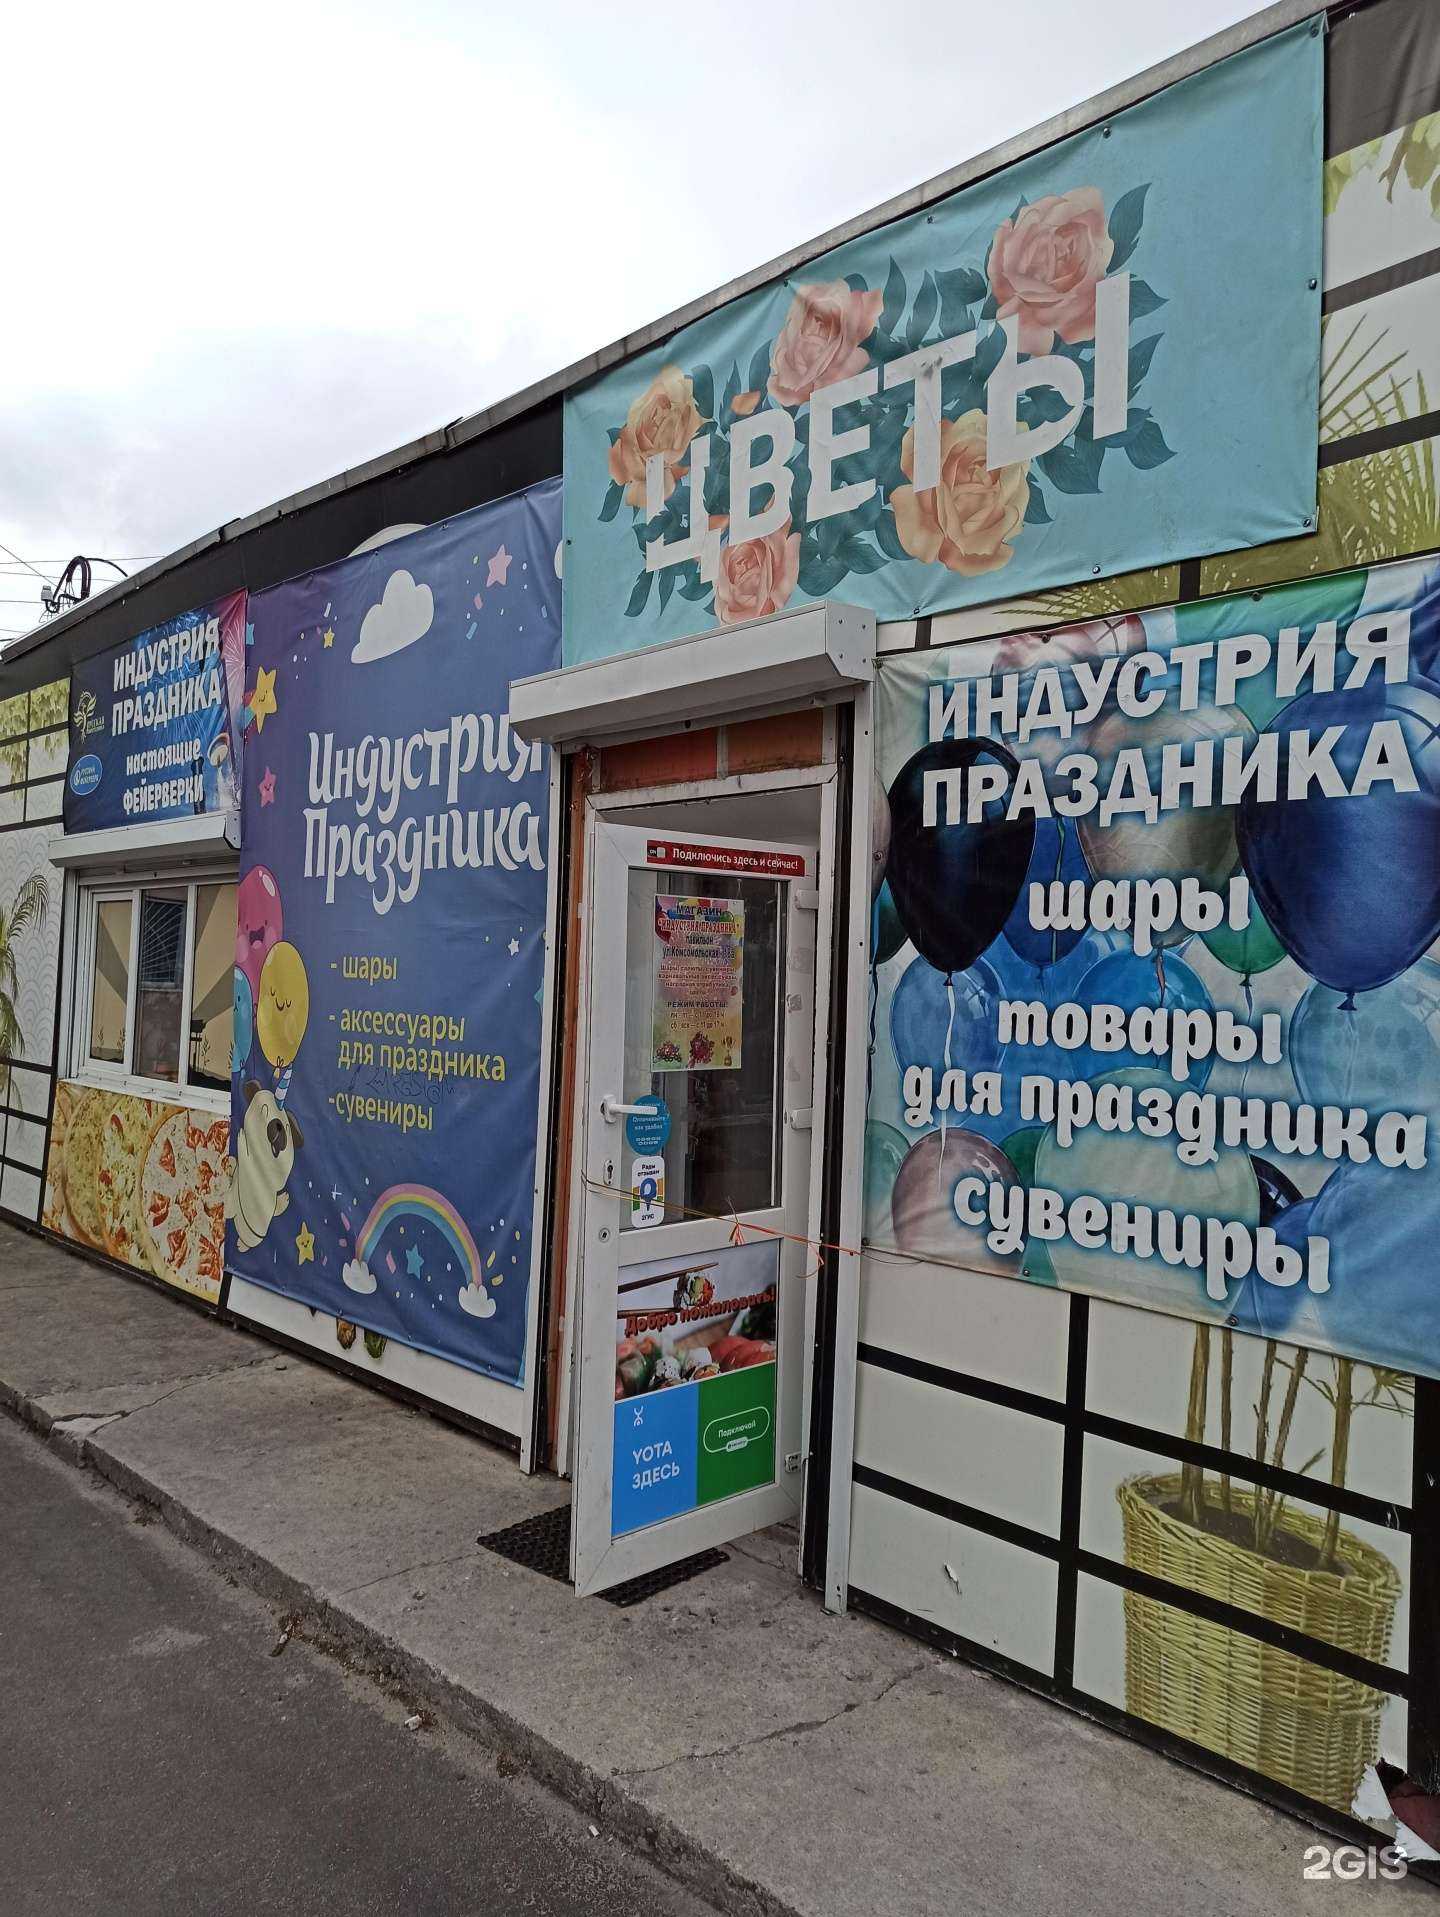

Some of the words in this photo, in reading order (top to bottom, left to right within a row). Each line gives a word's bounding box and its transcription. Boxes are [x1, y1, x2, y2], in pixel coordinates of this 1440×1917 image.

[646, 271, 1130, 585] ЦВЕТЫ
[114, 617, 220, 692] ИНДУСТРИЯ
[927, 607, 1413, 742] ИНДУСТРИЯ
[112, 668, 222, 737] ПРАЗДНИКА
[126, 737, 201, 777] настоящие
[922, 719, 1420, 827] ПРАЗДНИКА
[123, 774, 204, 816] ФЕЙЕРВЕРКИ
[303, 801, 546, 915] Праздника
[673, 848, 732, 864] Подключись
[733, 855, 758, 867] здесь
[759, 857, 766, 867] и
[767, 858, 798, 870] сейчас!
[676, 904, 722, 916] МАГАЗИН
[1027, 874, 1251, 957] шары
[343, 956, 398, 986] шары
[340, 1008, 465, 1046] аксессуары
[997, 998, 1284, 1082] товары
[338, 1040, 374, 1070] для
[380, 1043, 506, 1082] праздника
[329, 1092, 433, 1133] -сувениры
[902, 1062, 1002, 1128] для
[1019, 1071, 1430, 1171] праздника
[952, 1174, 1333, 1300] сувениры
[625, 1314, 678, 1338] Добро
[680, 1290, 775, 1324] пожаловать!
[632, 1462, 680, 1490] ЗДЕСЬ
[633, 1440, 673, 1465] YOTA
